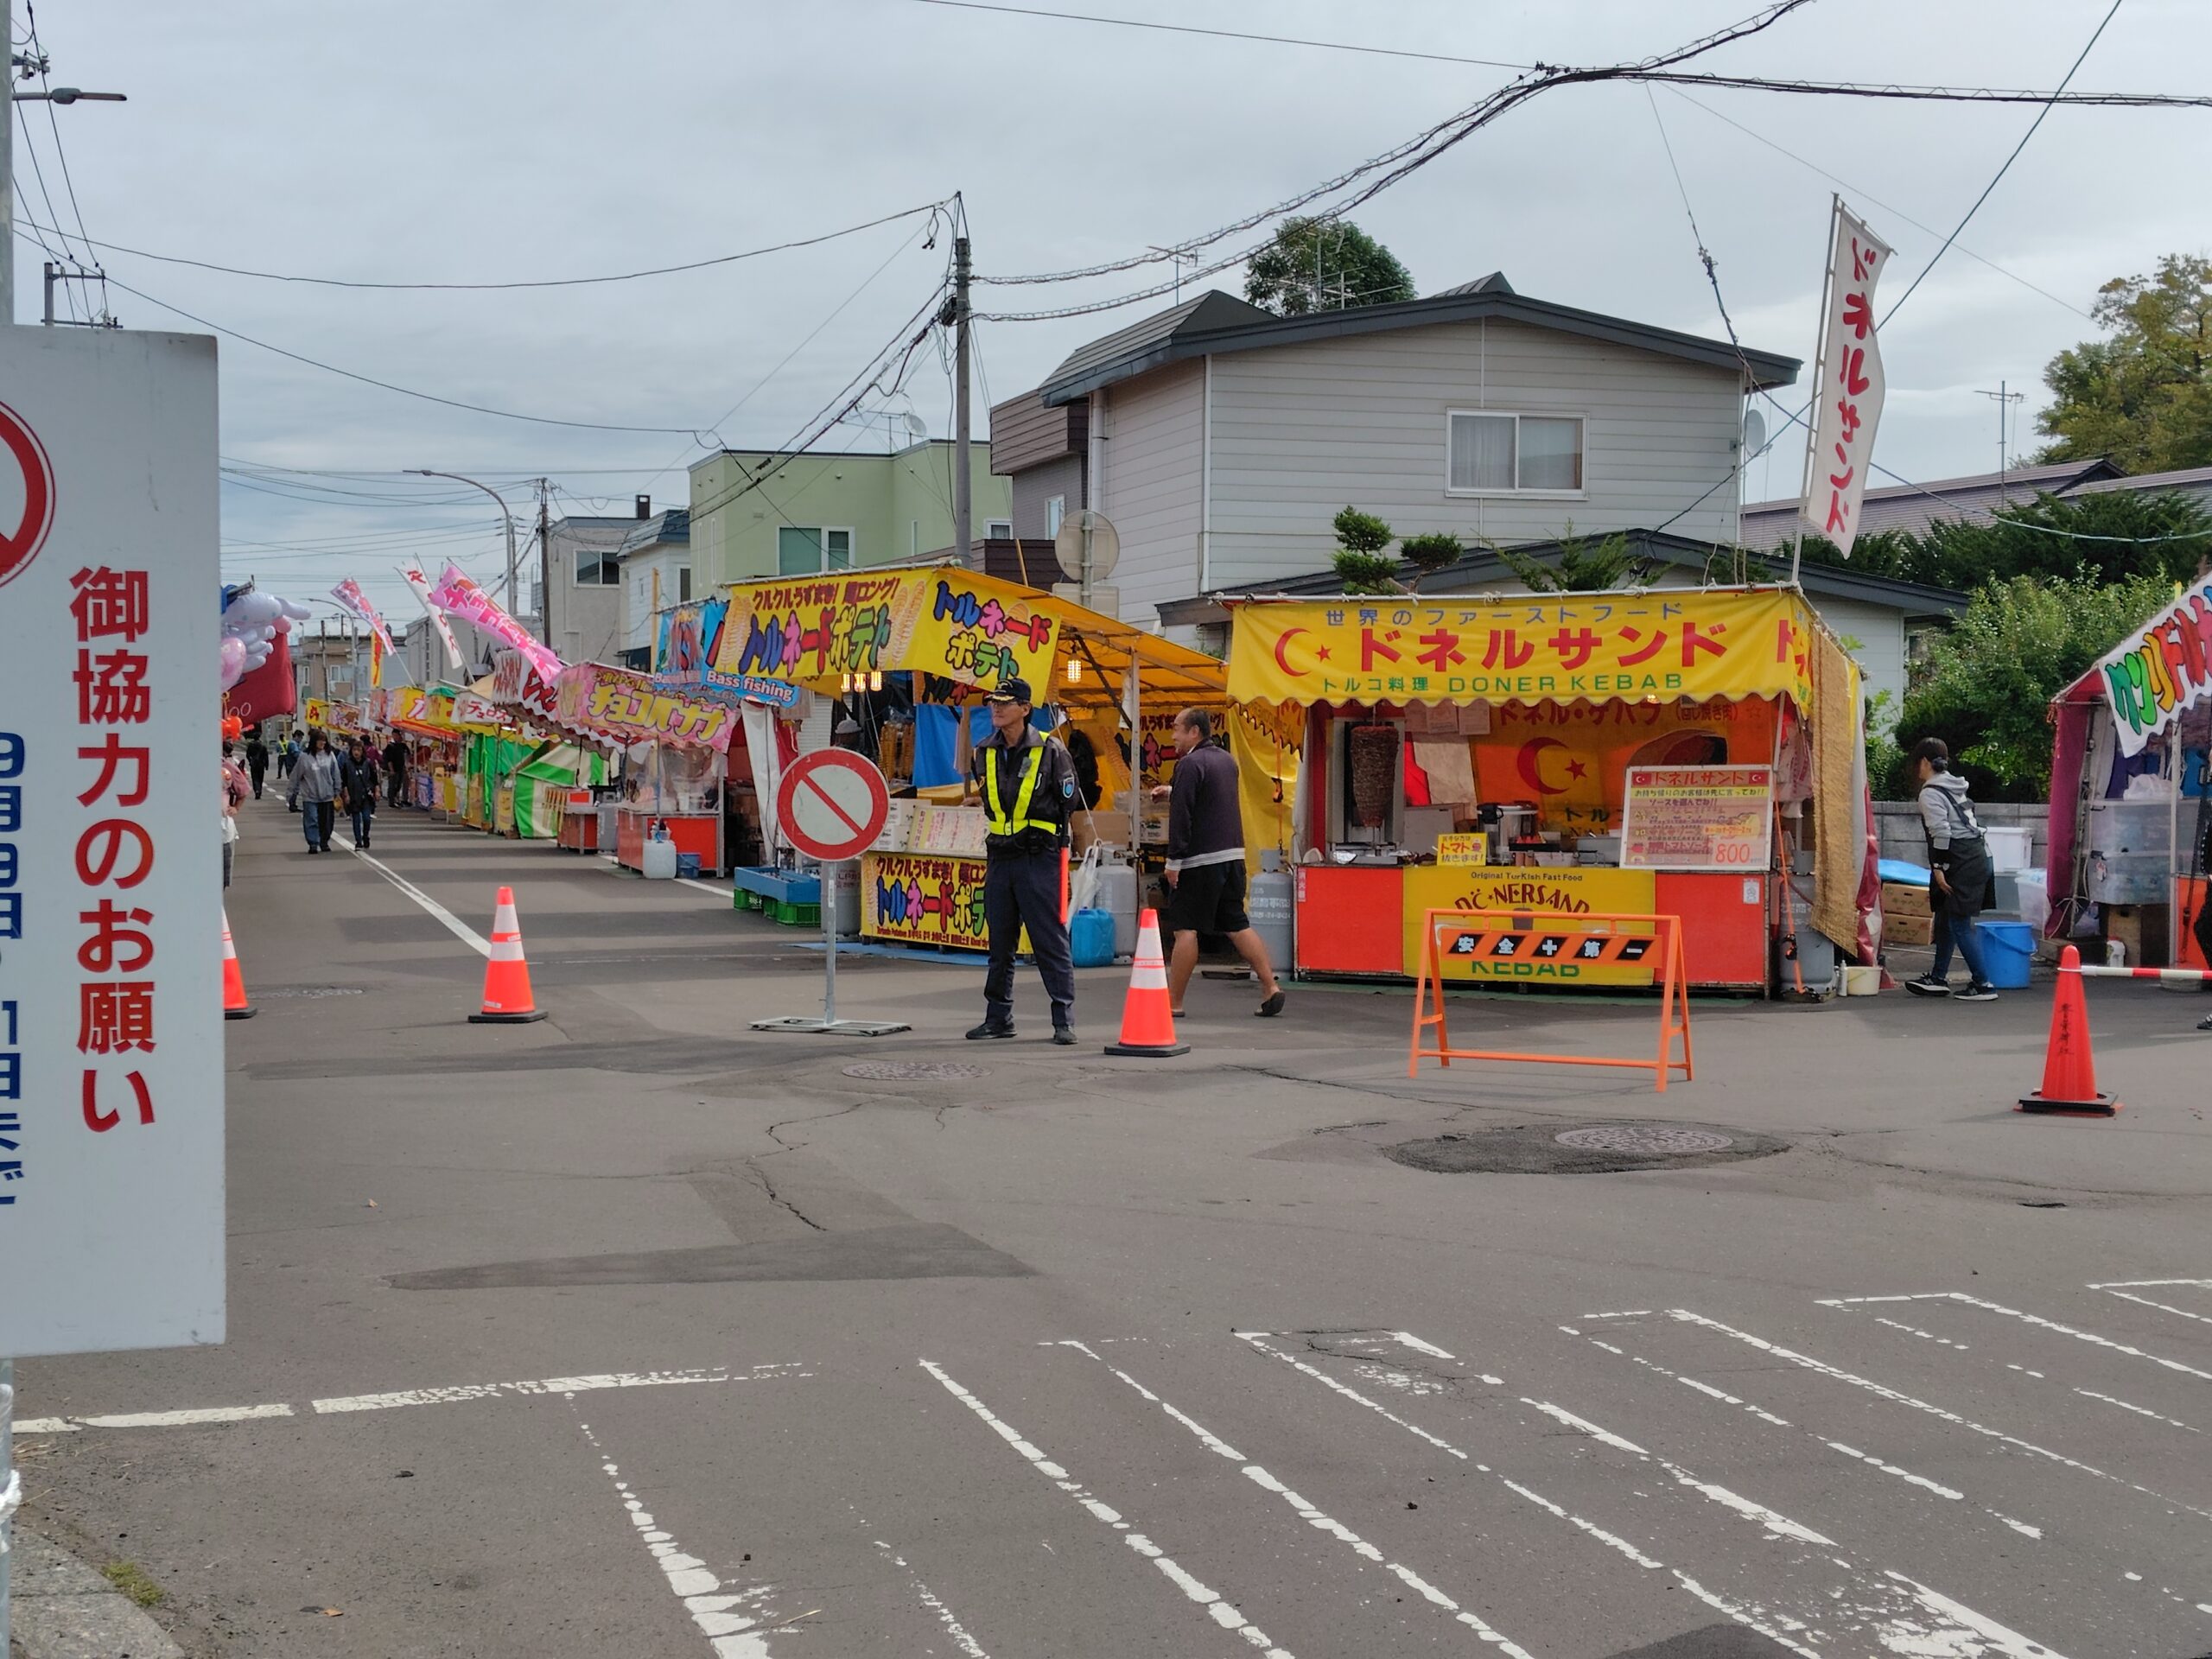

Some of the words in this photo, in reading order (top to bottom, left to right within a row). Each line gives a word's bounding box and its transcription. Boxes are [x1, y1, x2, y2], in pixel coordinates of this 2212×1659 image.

[1825, 237, 1878, 534] ドネルサンド
[933, 581, 1052, 653] トルネード
[1325, 602, 1682, 626] 世界のファーストフード
[738, 601, 892, 677] トルネードポテト
[1361, 621, 1728, 672] ドネルサンド
[945, 630, 1020, 684] ポテト
[706, 670, 741, 689] Bass
[743, 679, 793, 702] fishing
[1323, 677, 1429, 692] トルコ料理
[1448, 676, 1555, 693] DONER
[1570, 673, 1682, 691] KEBAB
[69, 565, 157, 1134] 御協力のお願い
[1441, 842, 1470, 854] トマト
[1715, 843, 1751, 863] 800
[1471, 871, 1503, 880] Original
[1542, 873, 1561, 881] Fast
